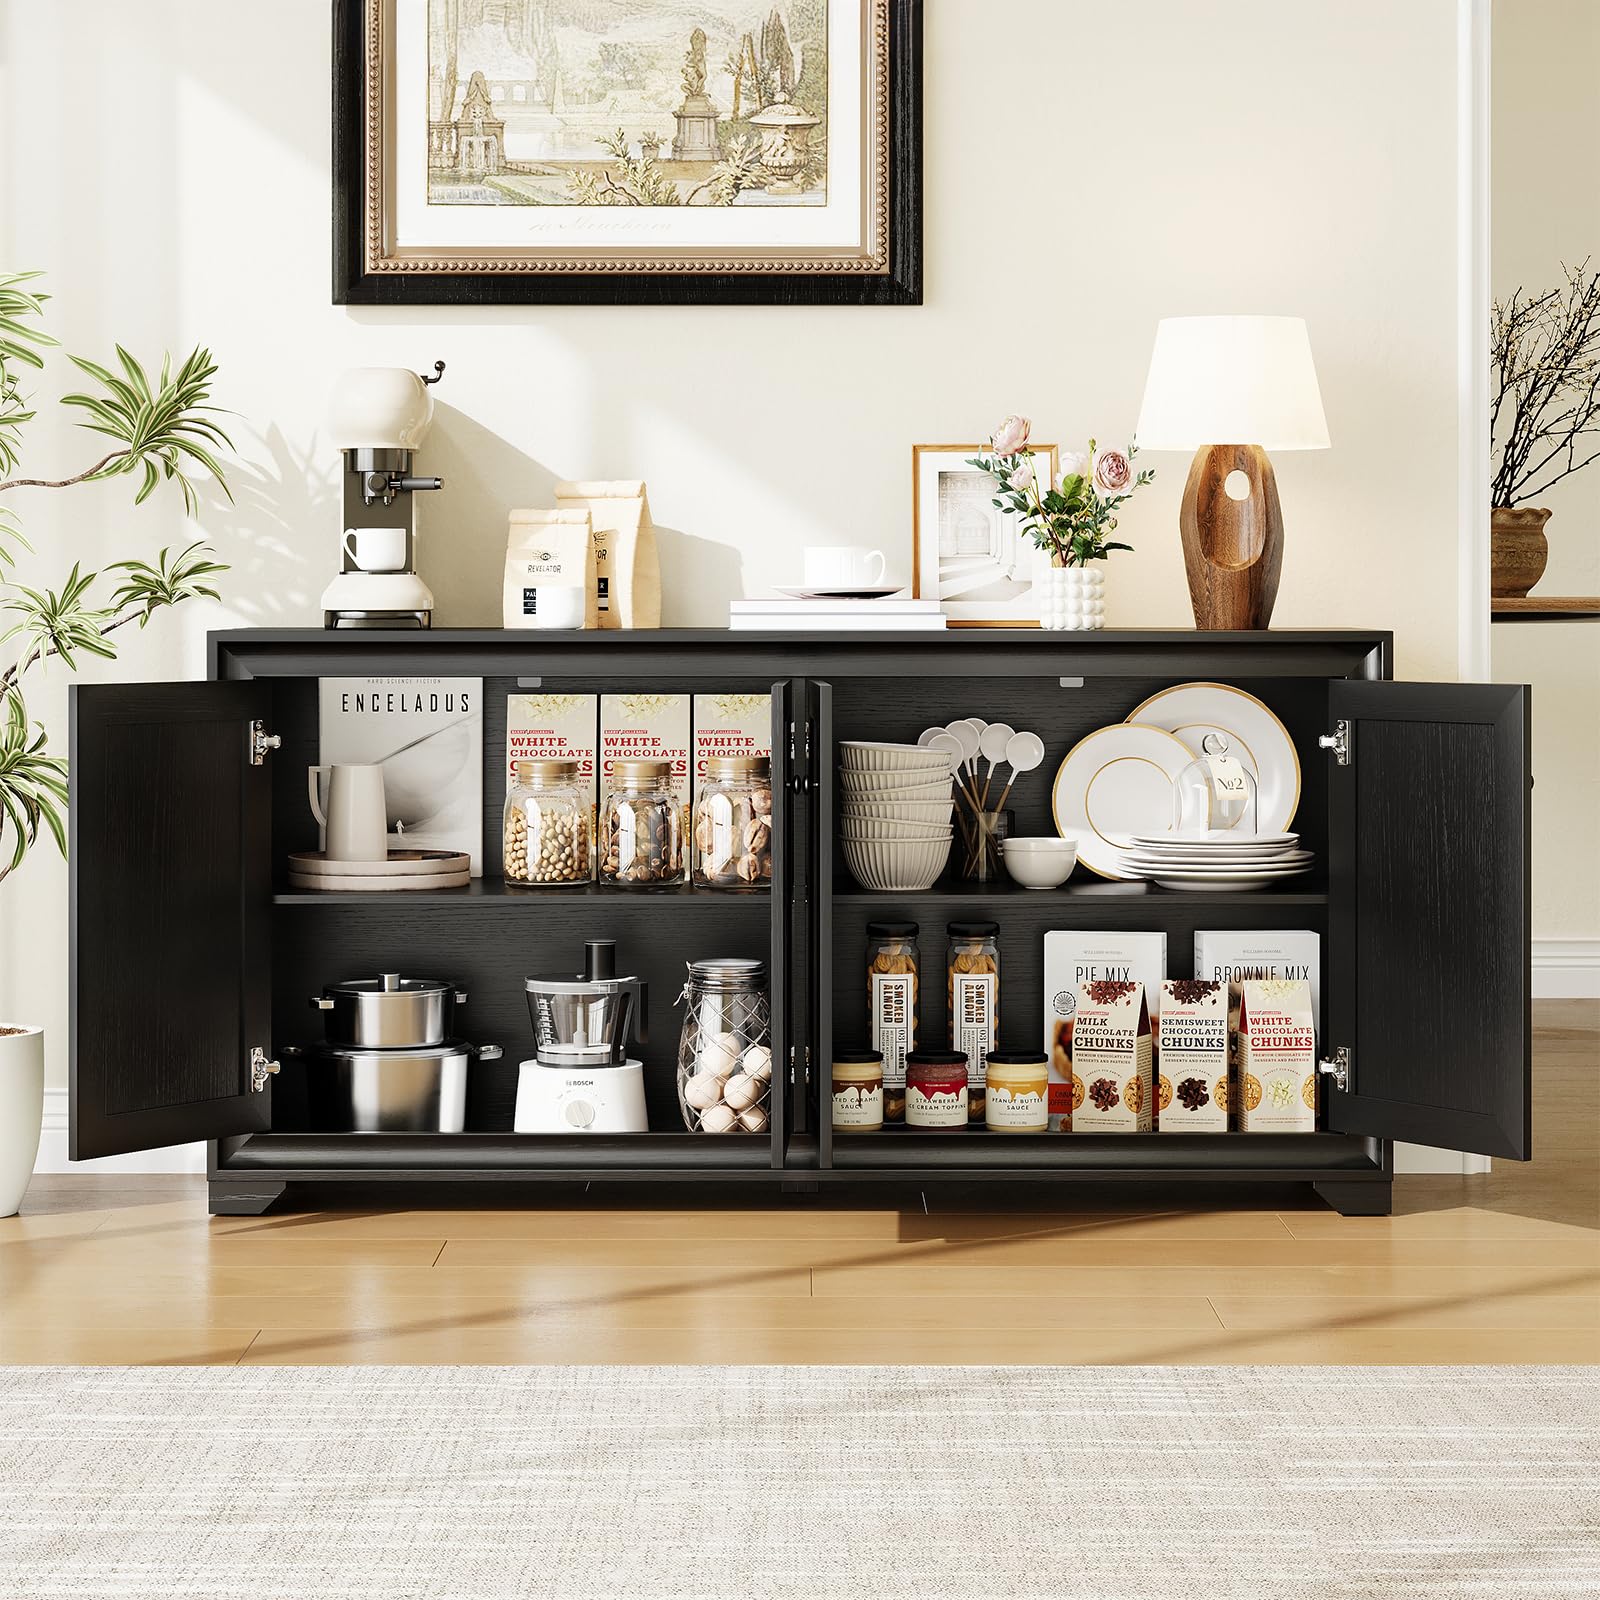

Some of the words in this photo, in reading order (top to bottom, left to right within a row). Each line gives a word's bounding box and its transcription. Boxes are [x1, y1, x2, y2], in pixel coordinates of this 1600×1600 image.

[528, 565, 562, 574] REVELATOR
[342, 693, 469, 712] ENCELADUS
[511, 737, 568, 747] WHITE
[604, 737, 661, 747] WHITE
[698, 737, 755, 747] WHITE
[510, 749, 593, 757] CHOCOLATE
[604, 749, 687, 757] CHOCOLATE
[698, 749, 771, 757] CHOCOLAT
[1076, 966, 1097, 983] PIE
[1105, 967, 1130, 982] MIX
[1214, 965, 1277, 983] BROWNIE
[1285, 965, 1310, 981] MIX
[883, 984, 893, 1023] ALMOND
[894, 984, 903, 1024] SMOKED
[965, 984, 975, 1023] ALMOND
[976, 984, 985, 1024] SMOKED
[1077, 1017, 1108, 1026] MILK
[1250, 1017, 1292, 1025] WHITE
[898, 1029, 905, 1041] 03
[979, 1029, 986, 1041] 03
[1075, 1027, 1135, 1036] CHOCOLATE
[1074, 1037, 1134, 1049] CHUNKS
[1162, 1037, 1224, 1048] CHUNKS
[1251, 1036, 1313, 1047] CHUNKS
